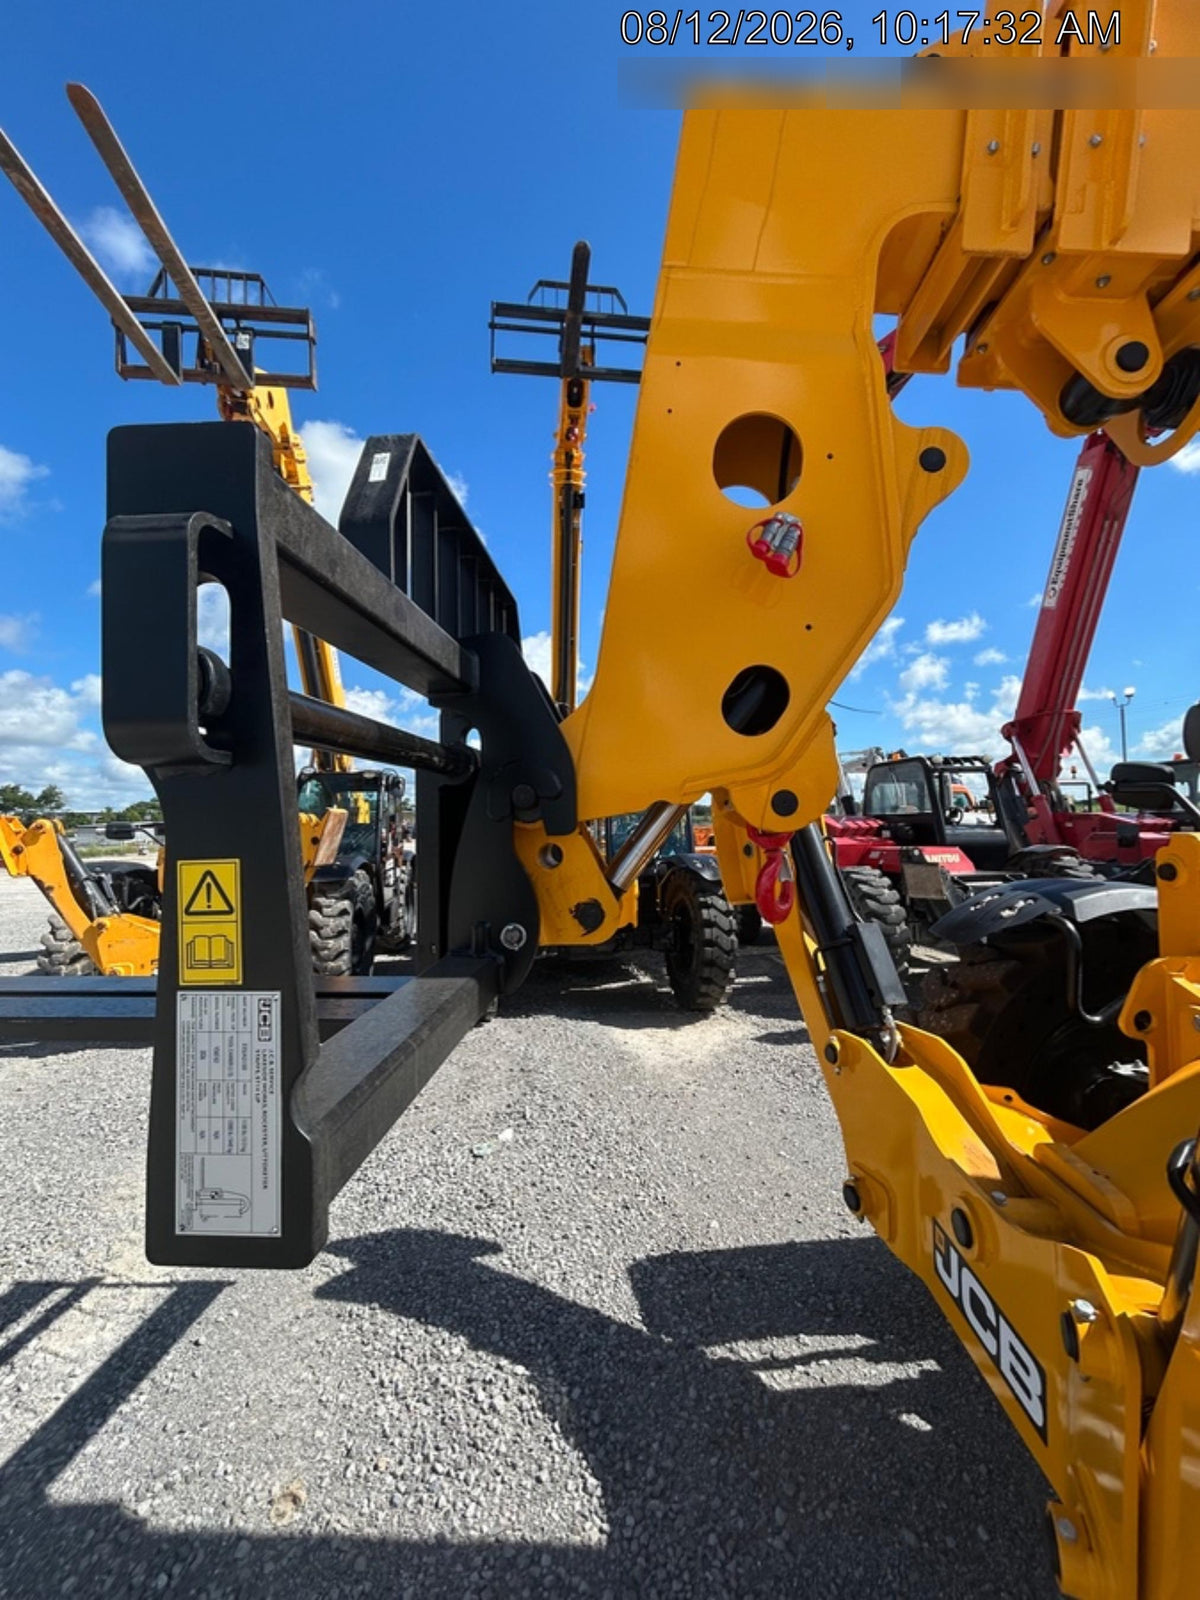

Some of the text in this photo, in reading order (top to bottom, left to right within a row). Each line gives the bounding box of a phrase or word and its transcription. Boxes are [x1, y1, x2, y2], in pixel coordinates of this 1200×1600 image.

[924, 853, 960, 863] ANITOU
[258, 999, 271, 1041] JCB
[936, 1246, 1044, 1427] JCB
